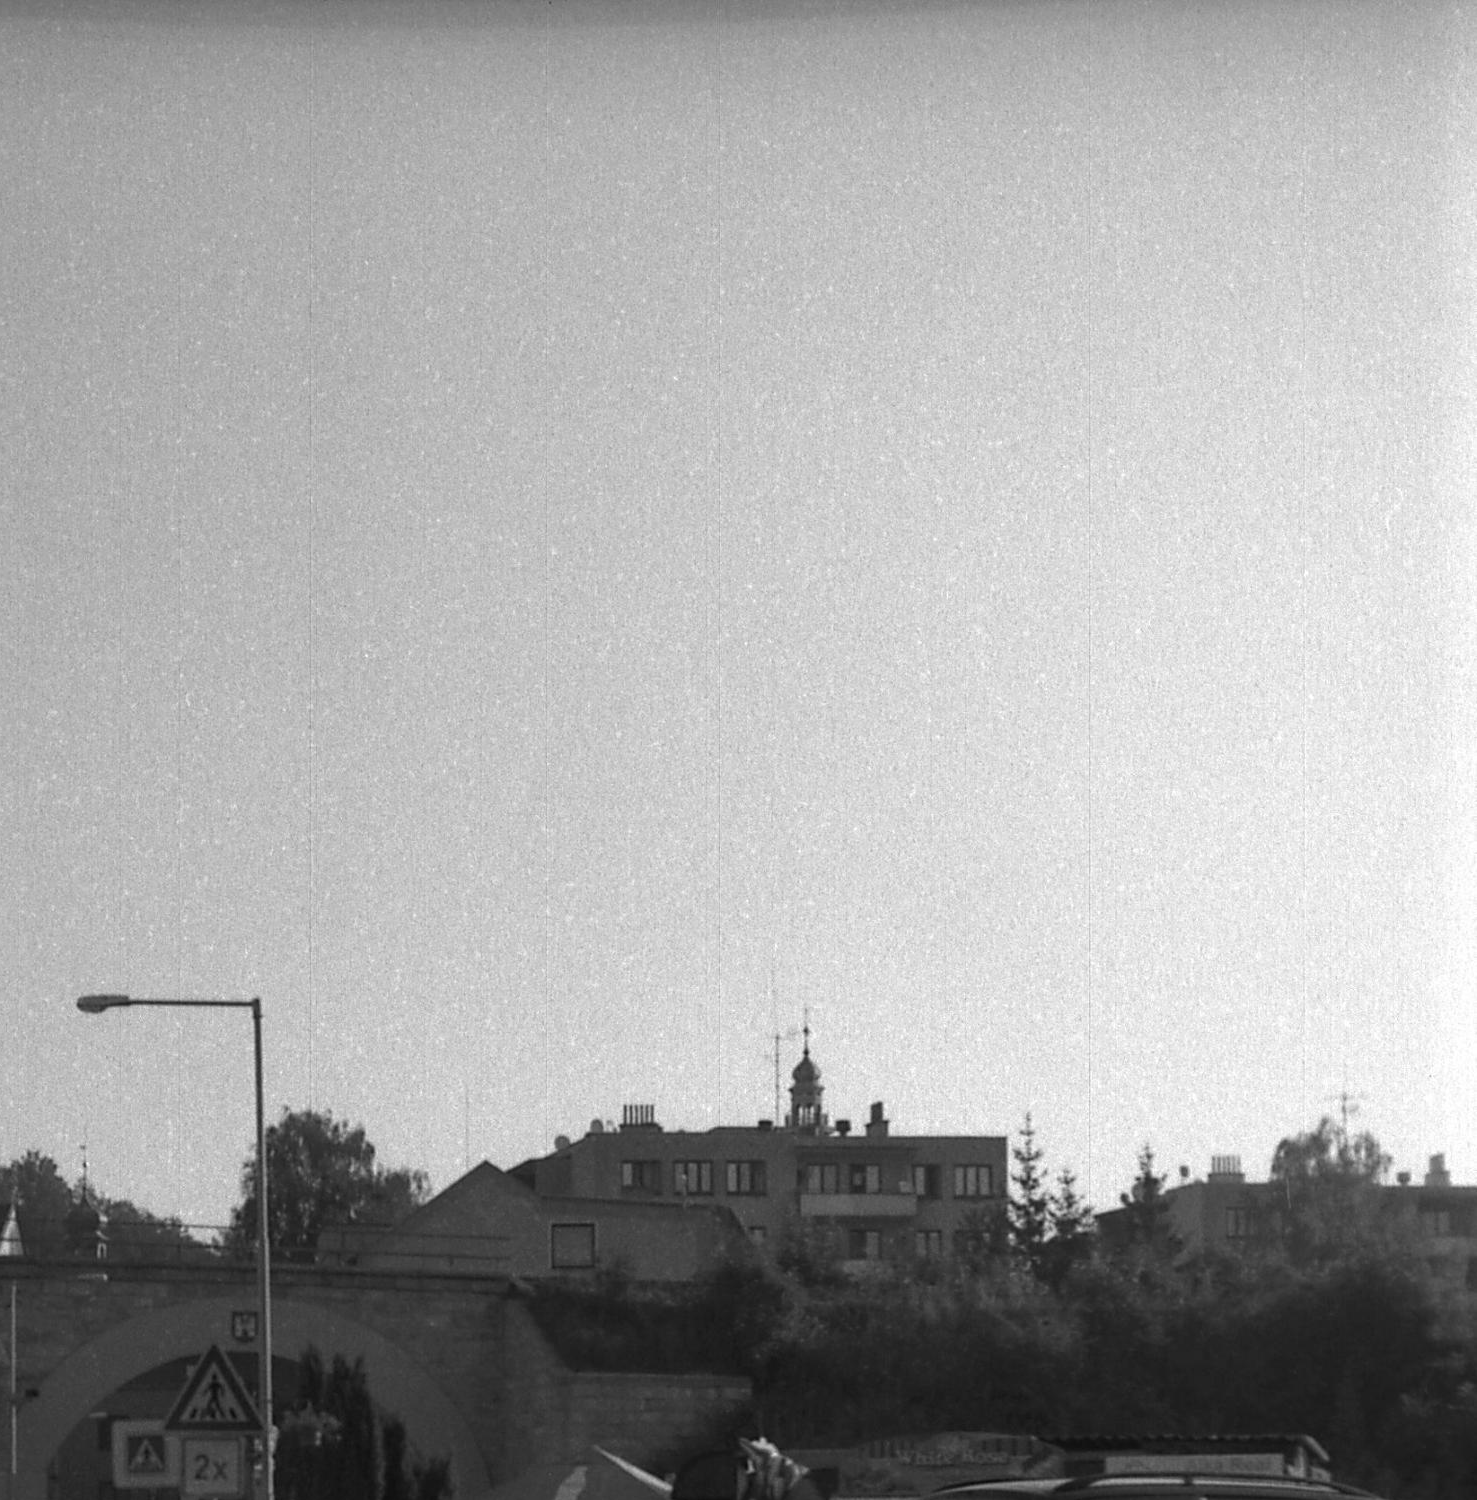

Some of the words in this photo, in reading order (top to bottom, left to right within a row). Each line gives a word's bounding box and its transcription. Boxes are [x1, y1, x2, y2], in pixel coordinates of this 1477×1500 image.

[194, 1455, 228, 1481] 2x
[896, 1449, 954, 1466] White
[961, 1450, 1009, 1465] Rose
